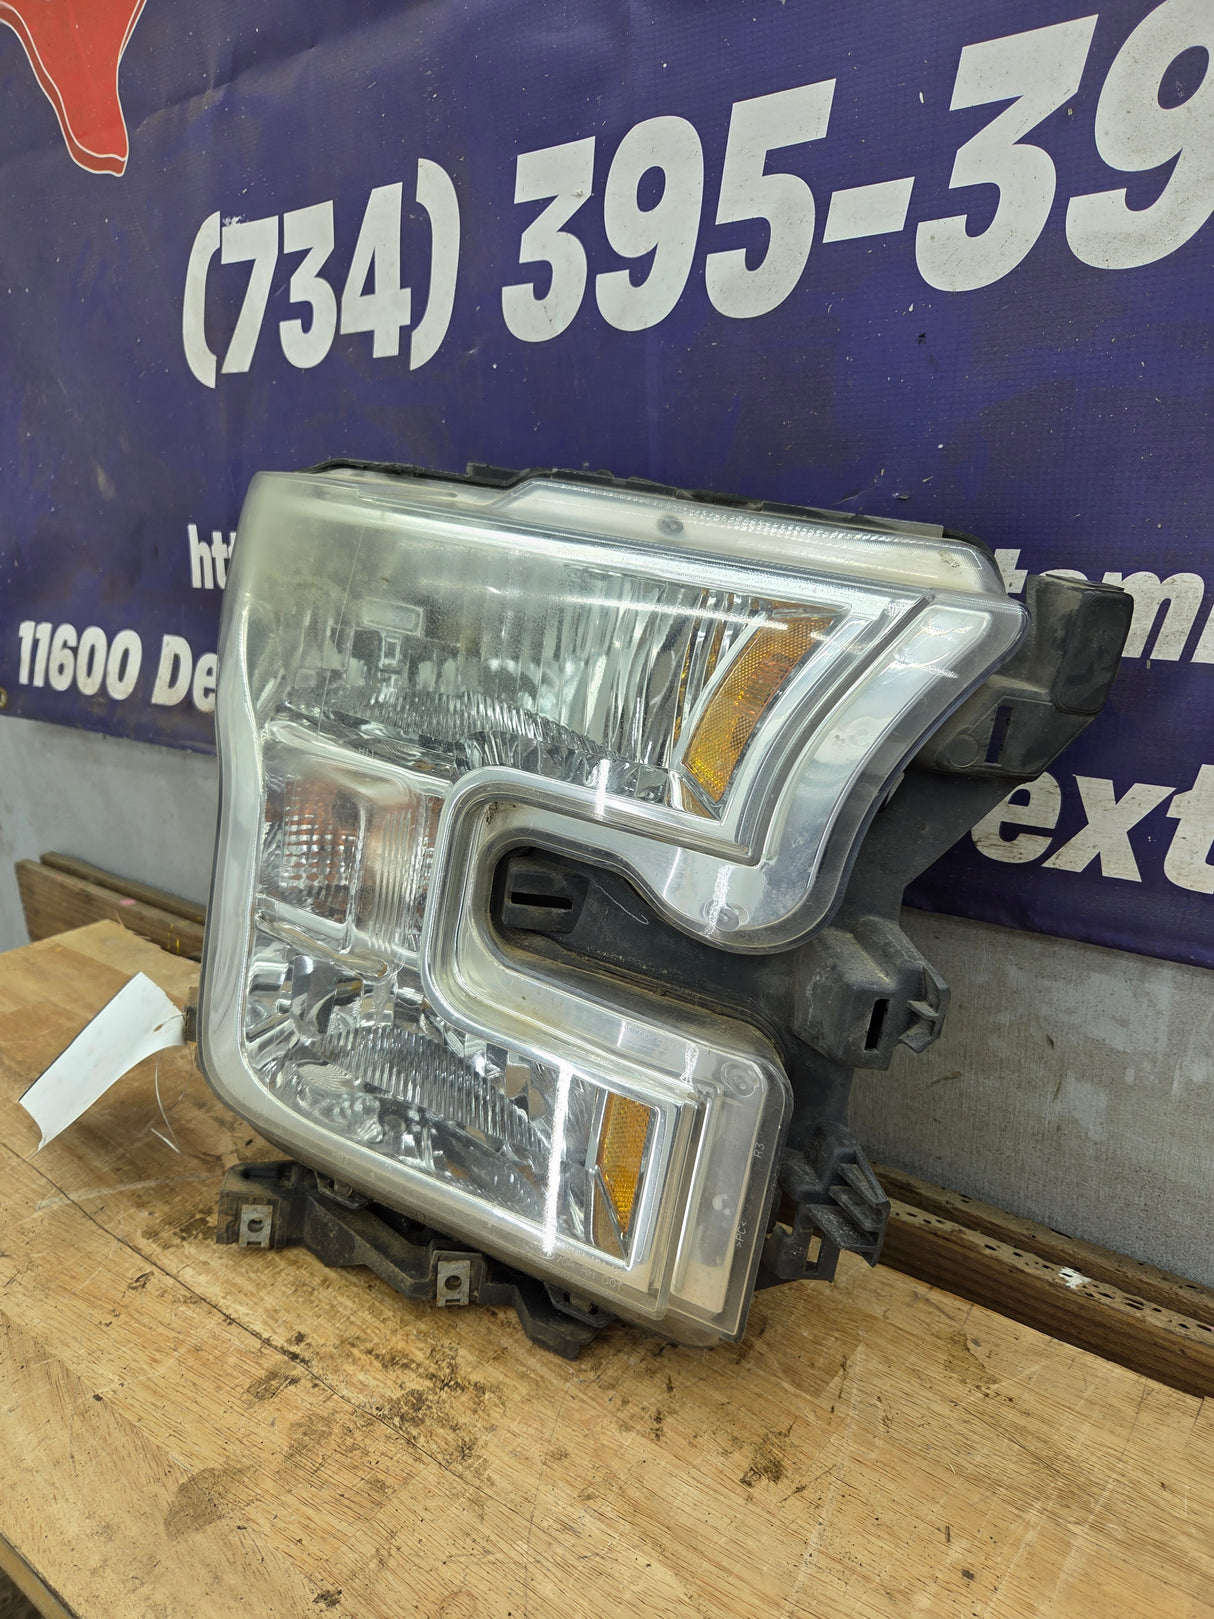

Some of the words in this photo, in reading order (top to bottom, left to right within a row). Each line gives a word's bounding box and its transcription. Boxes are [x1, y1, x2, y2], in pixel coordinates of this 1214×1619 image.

[182, 158, 460, 389] (734)
[501, 0, 1214, 343] 395-39
[18, 620, 142, 700] 11600
